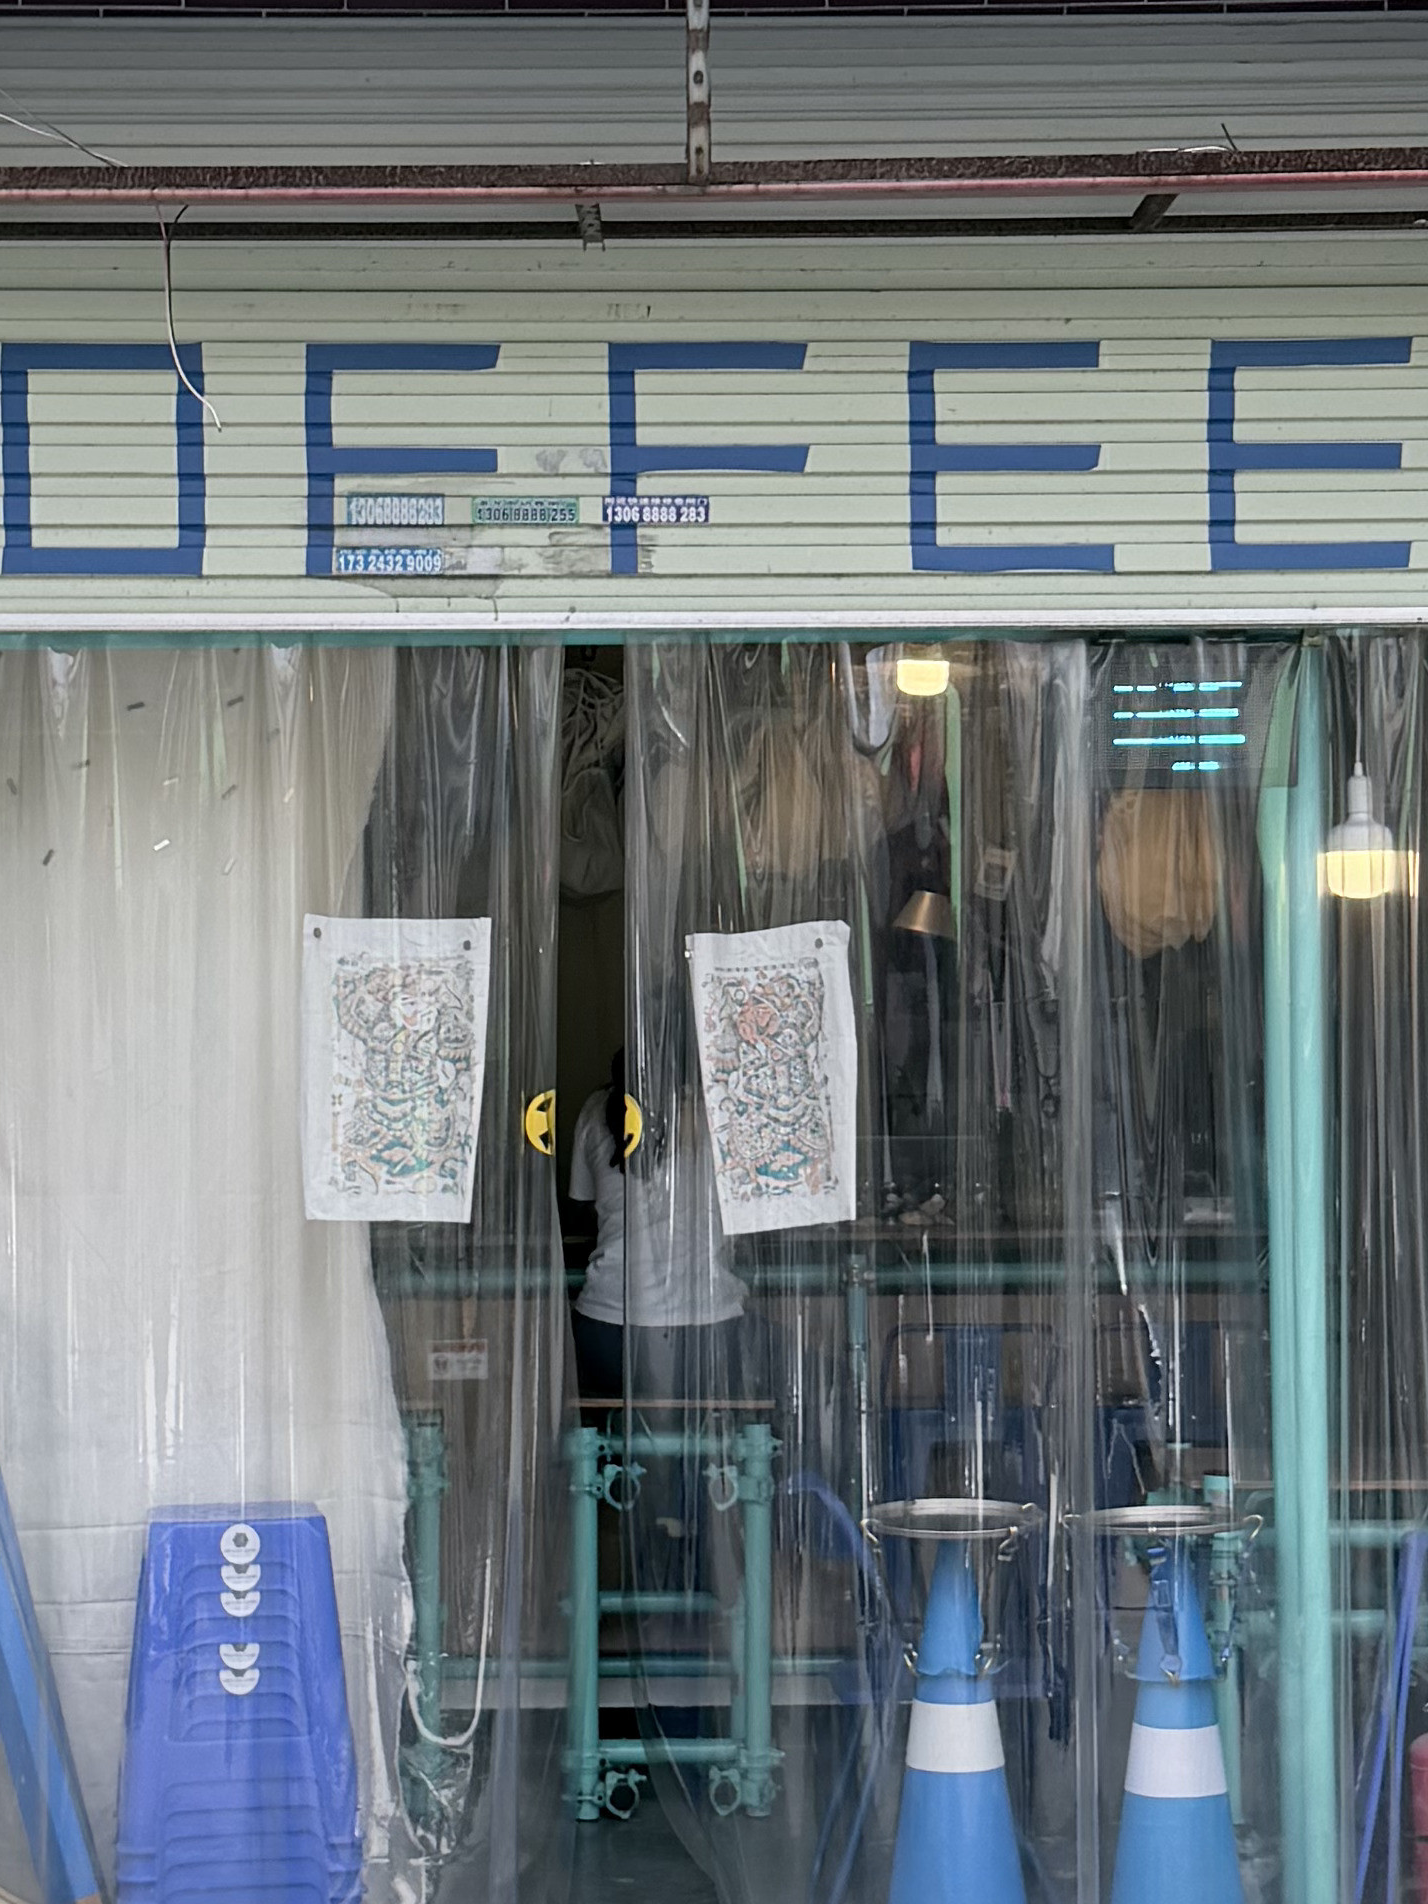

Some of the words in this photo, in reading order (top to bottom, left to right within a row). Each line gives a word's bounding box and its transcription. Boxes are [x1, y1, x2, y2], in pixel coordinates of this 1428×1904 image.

[605, 506, 640, 524] 1306
[642, 506, 677, 524] 8888
[679, 506, 707, 524] 283
[338, 554, 365, 573] 173
[367, 554, 404, 573] 2432
[406, 554, 442, 573] 9009
